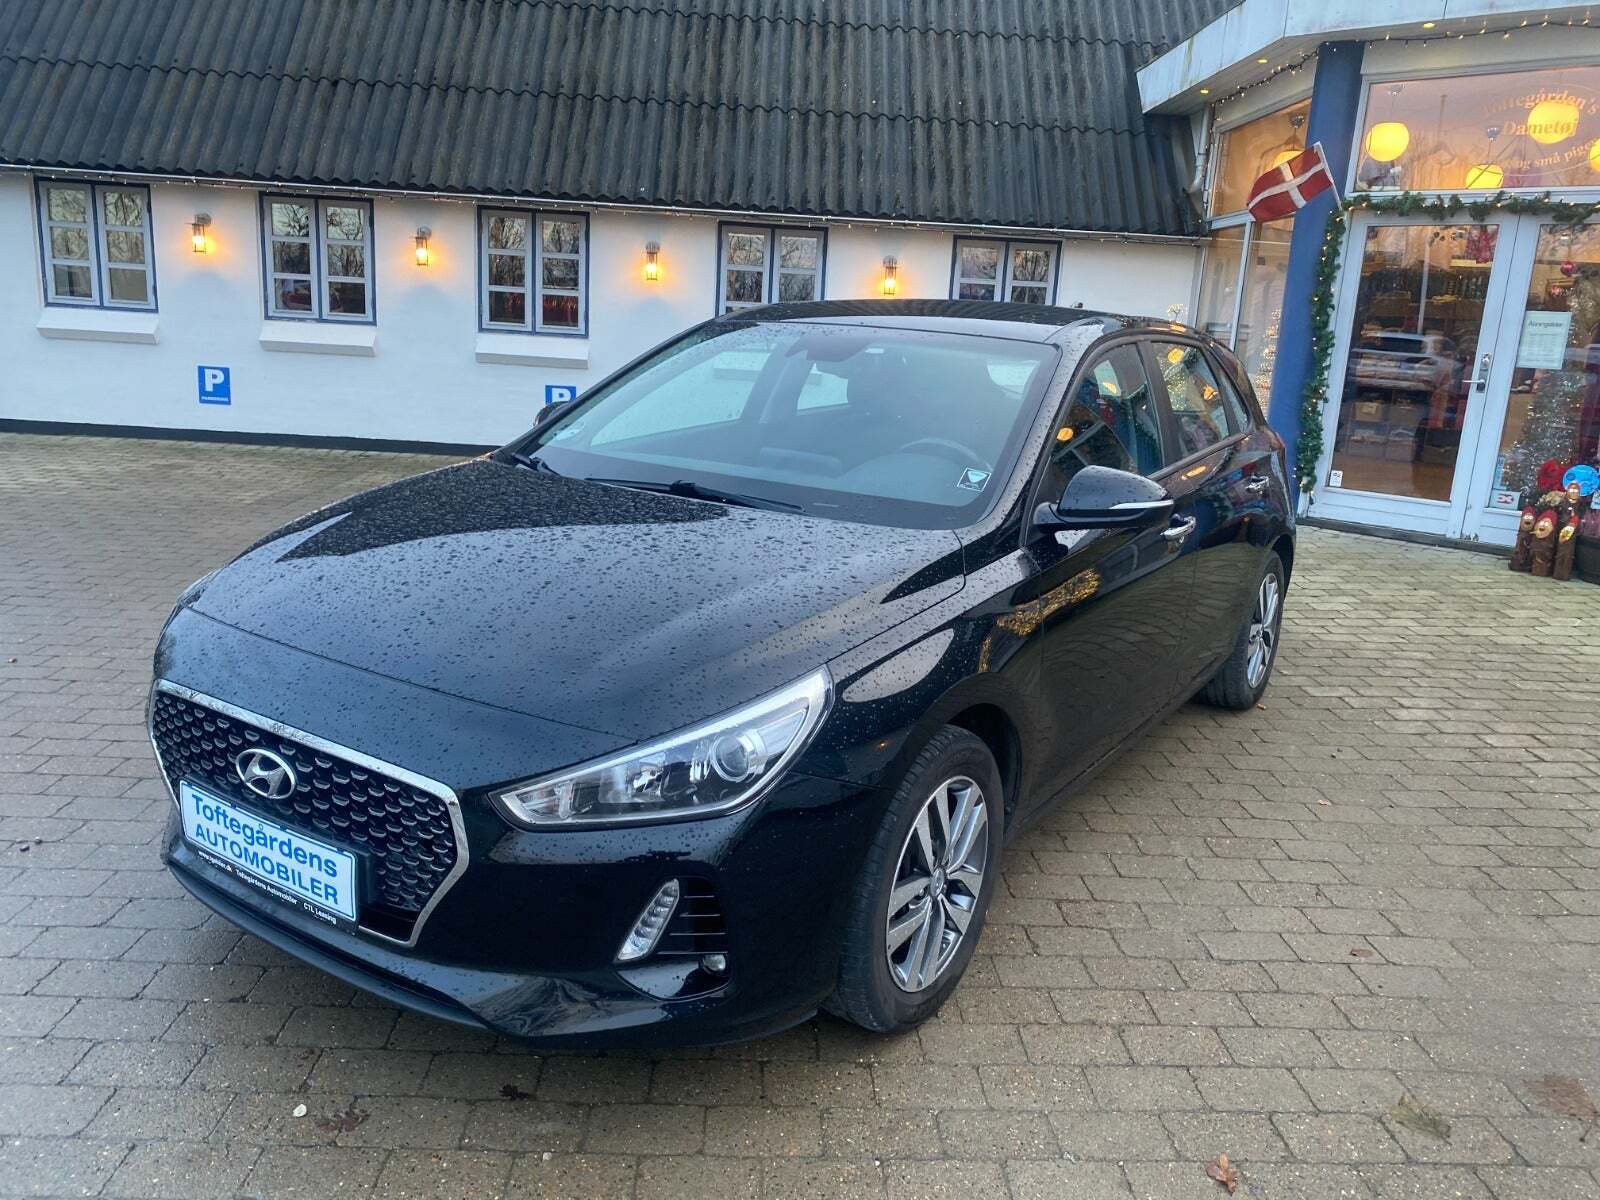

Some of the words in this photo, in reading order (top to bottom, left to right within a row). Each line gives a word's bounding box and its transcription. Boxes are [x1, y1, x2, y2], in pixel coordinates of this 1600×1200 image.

[1501, 118, 1579, 138] Dametøj
[1535, 151, 1561, 166] små
[204, 367, 225, 393] P
[551, 387, 572, 402] P
[191, 793, 338, 878] Toftegårdens
[195, 823, 339, 905] AUTOMOBILER
[303, 902, 315, 914] CTL
